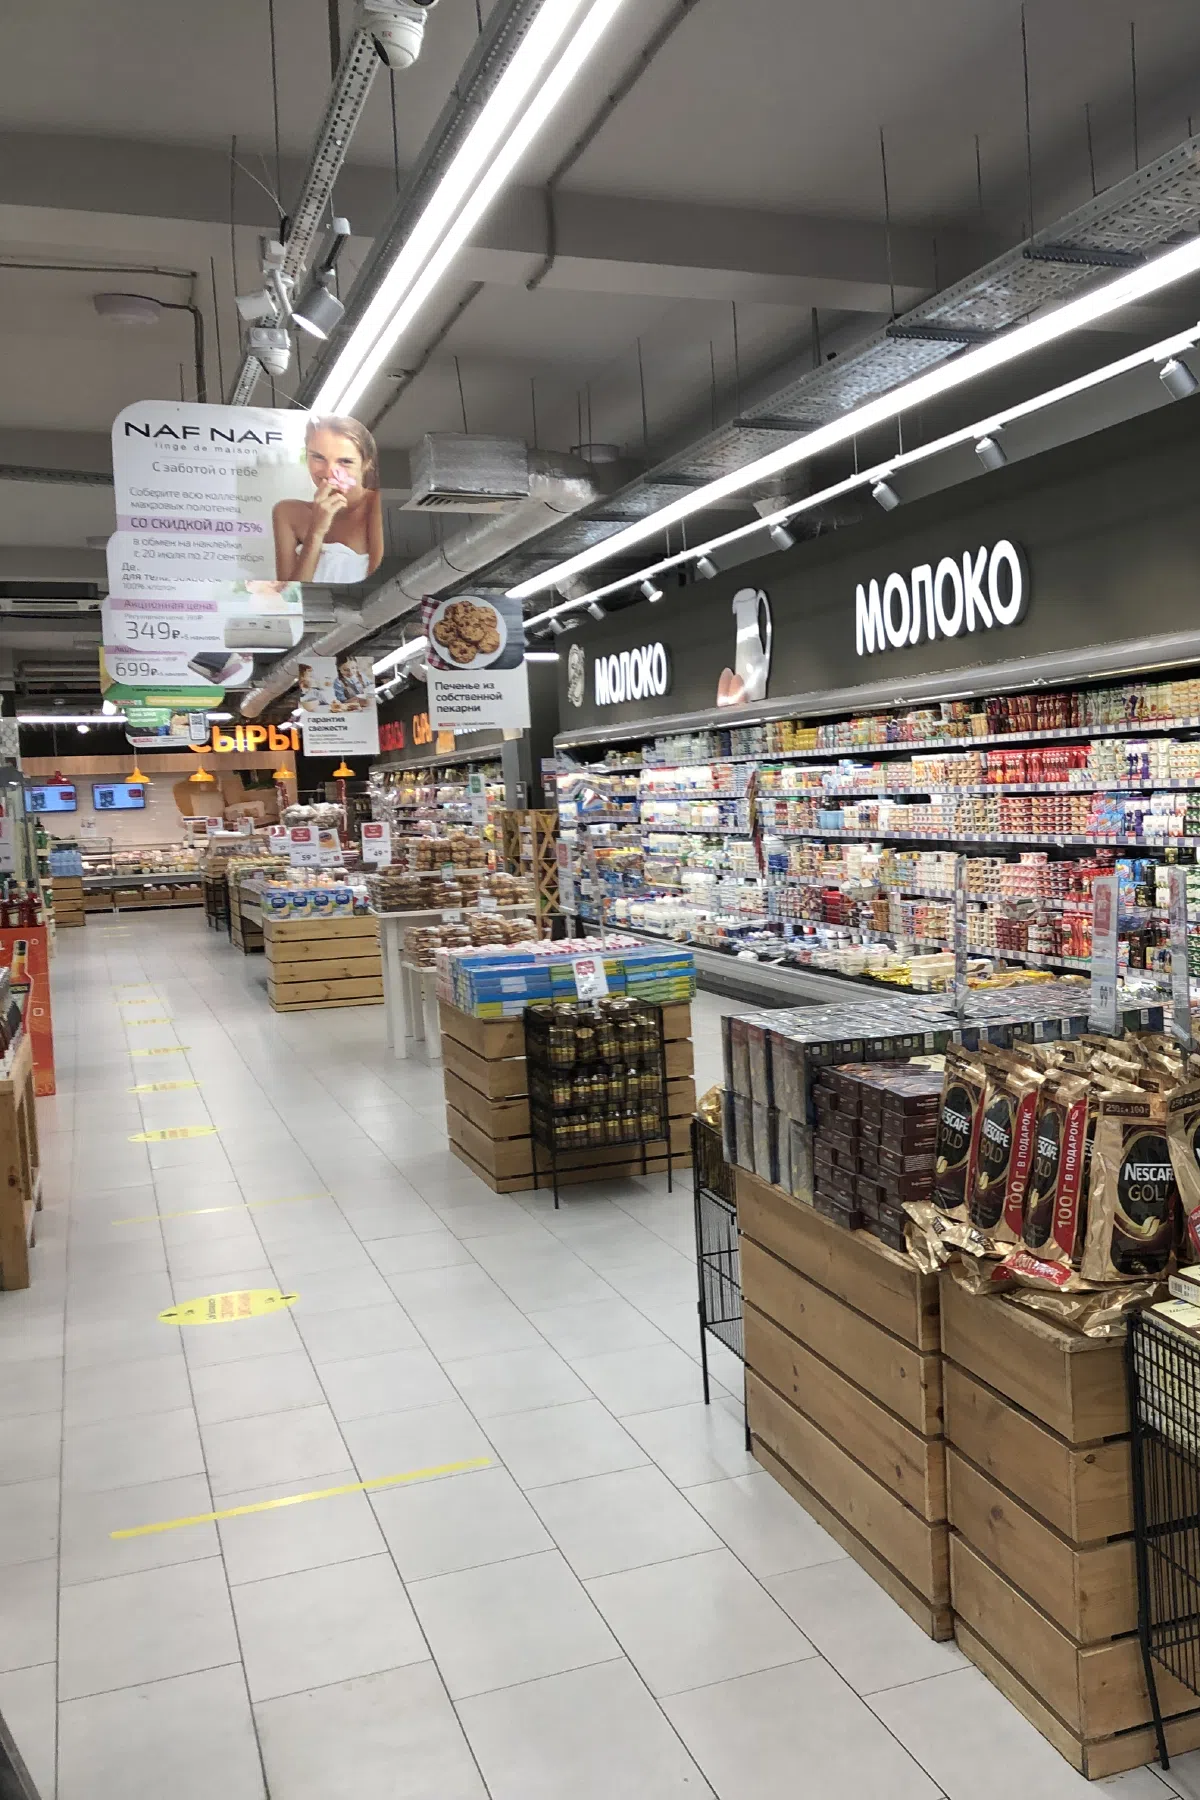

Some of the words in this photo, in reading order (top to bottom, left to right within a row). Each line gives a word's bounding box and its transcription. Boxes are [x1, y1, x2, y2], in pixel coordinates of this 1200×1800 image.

[124, 421, 200, 440] NAF
[209, 427, 283, 445] NAF
[193, 444, 208, 452] de
[214, 446, 259, 456] maison
[152, 461, 160, 473] С
[163, 461, 216, 475] заботой
[231, 465, 259, 477] тебе
[129, 487, 180, 500] Соберите
[183, 491, 204, 500] всю
[205, 492, 263, 504] коллекцию
[130, 501, 184, 513] махровых
[186, 503, 242, 515] полотенец
[130, 518, 149, 529] СО
[151, 517, 213, 532] СКИДКОЙ
[215, 521, 234, 533] ДО
[236, 522, 263, 533] 75%
[141, 538, 177, 548] обмен
[192, 541, 243, 550] наклейки
[141, 550, 155, 558] 20
[204, 551, 216, 561] 27
[217, 552, 265, 562] сентября
[124, 599, 185, 611] Акционная
[186, 603, 214, 611] цена
[855, 539, 1024, 656] МОЛОКО
[594, 641, 669, 706] МОЛОКО
[435, 681, 481, 691] Печенье
[483, 682, 495, 690] из
[436, 691, 503, 702] собственной
[436, 704, 482, 715] пекарни
[188, 724, 300, 753] ЫРЫ
[941, 1126, 964, 1149] OLD
[1009, 1181, 1025, 1212] 100
[1128, 1183, 1168, 1202] GOL
[1057, 1196, 1073, 1228] 100
